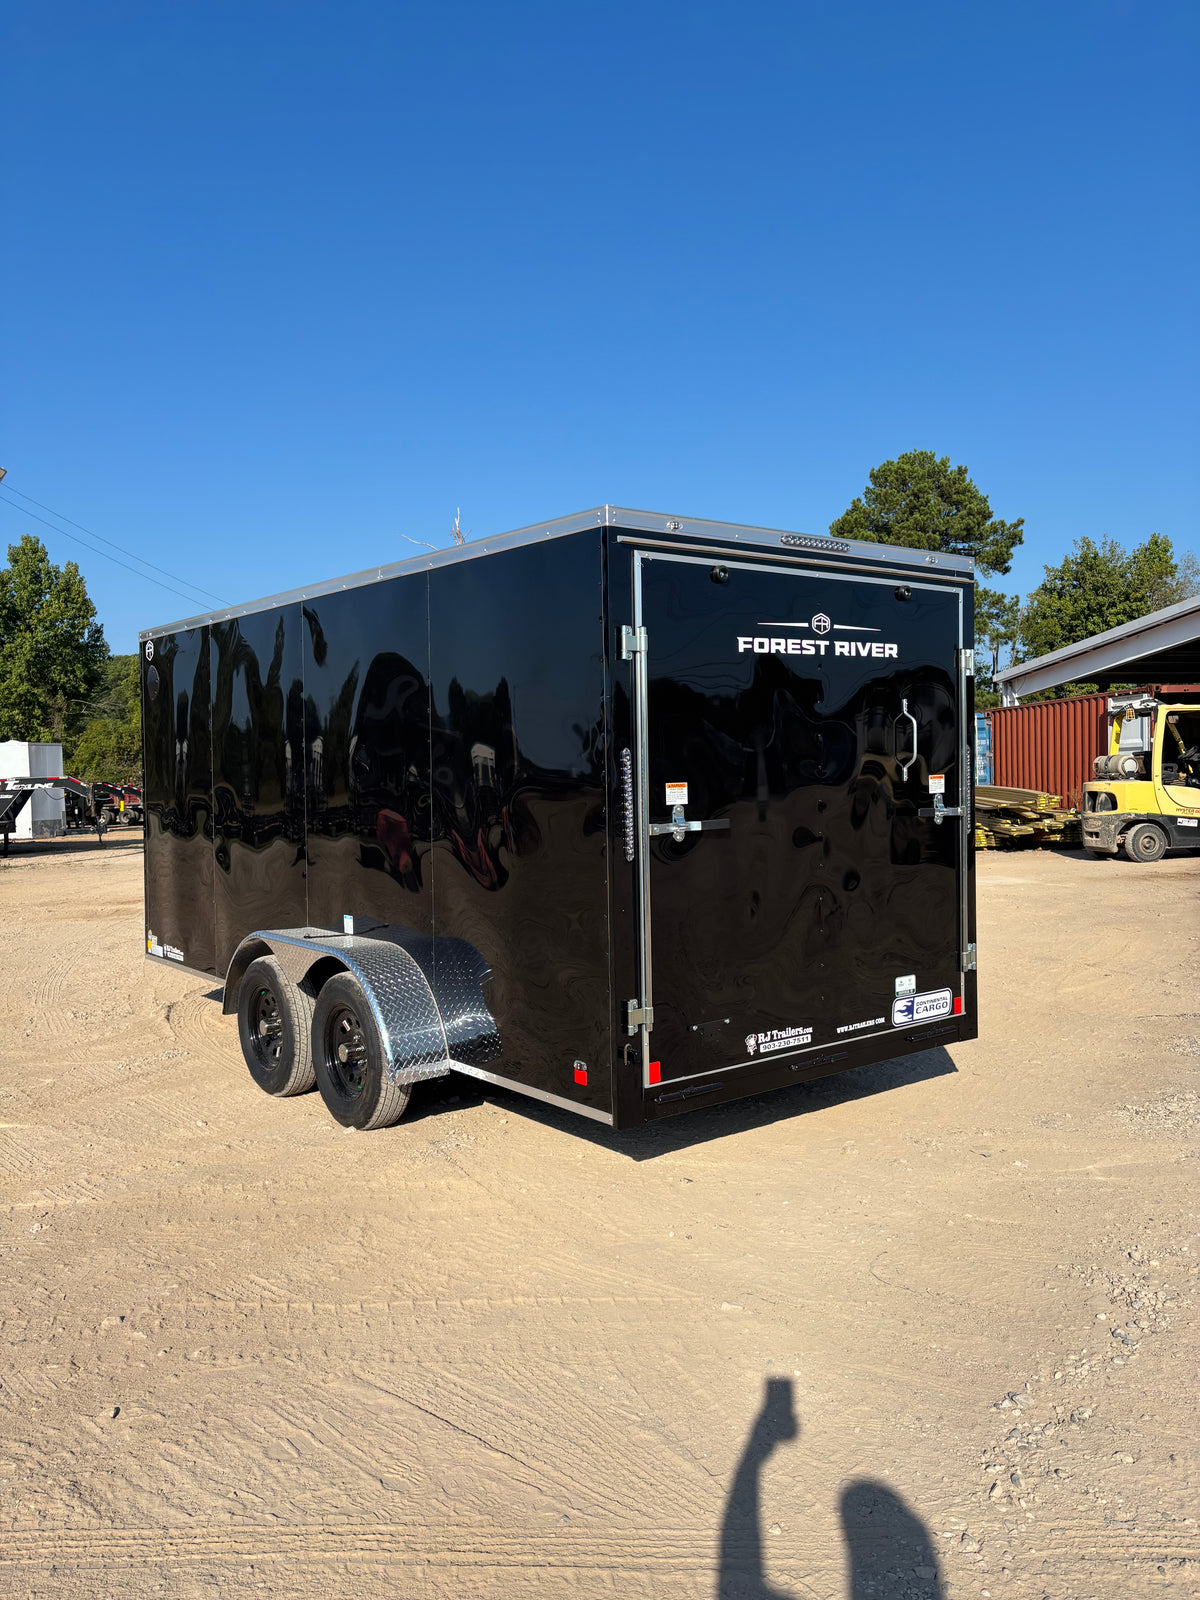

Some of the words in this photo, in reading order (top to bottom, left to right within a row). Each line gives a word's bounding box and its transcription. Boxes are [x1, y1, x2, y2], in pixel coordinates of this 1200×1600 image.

[737, 636, 830, 656] FOREST
[834, 641, 898, 658] RIVER
[915, 1001, 948, 1014] CARGO
[916, 996, 948, 1007] CONTINENTAL
[757, 1031, 771, 1044] RJ
[762, 1035, 809, 1051] 903-230-7511
